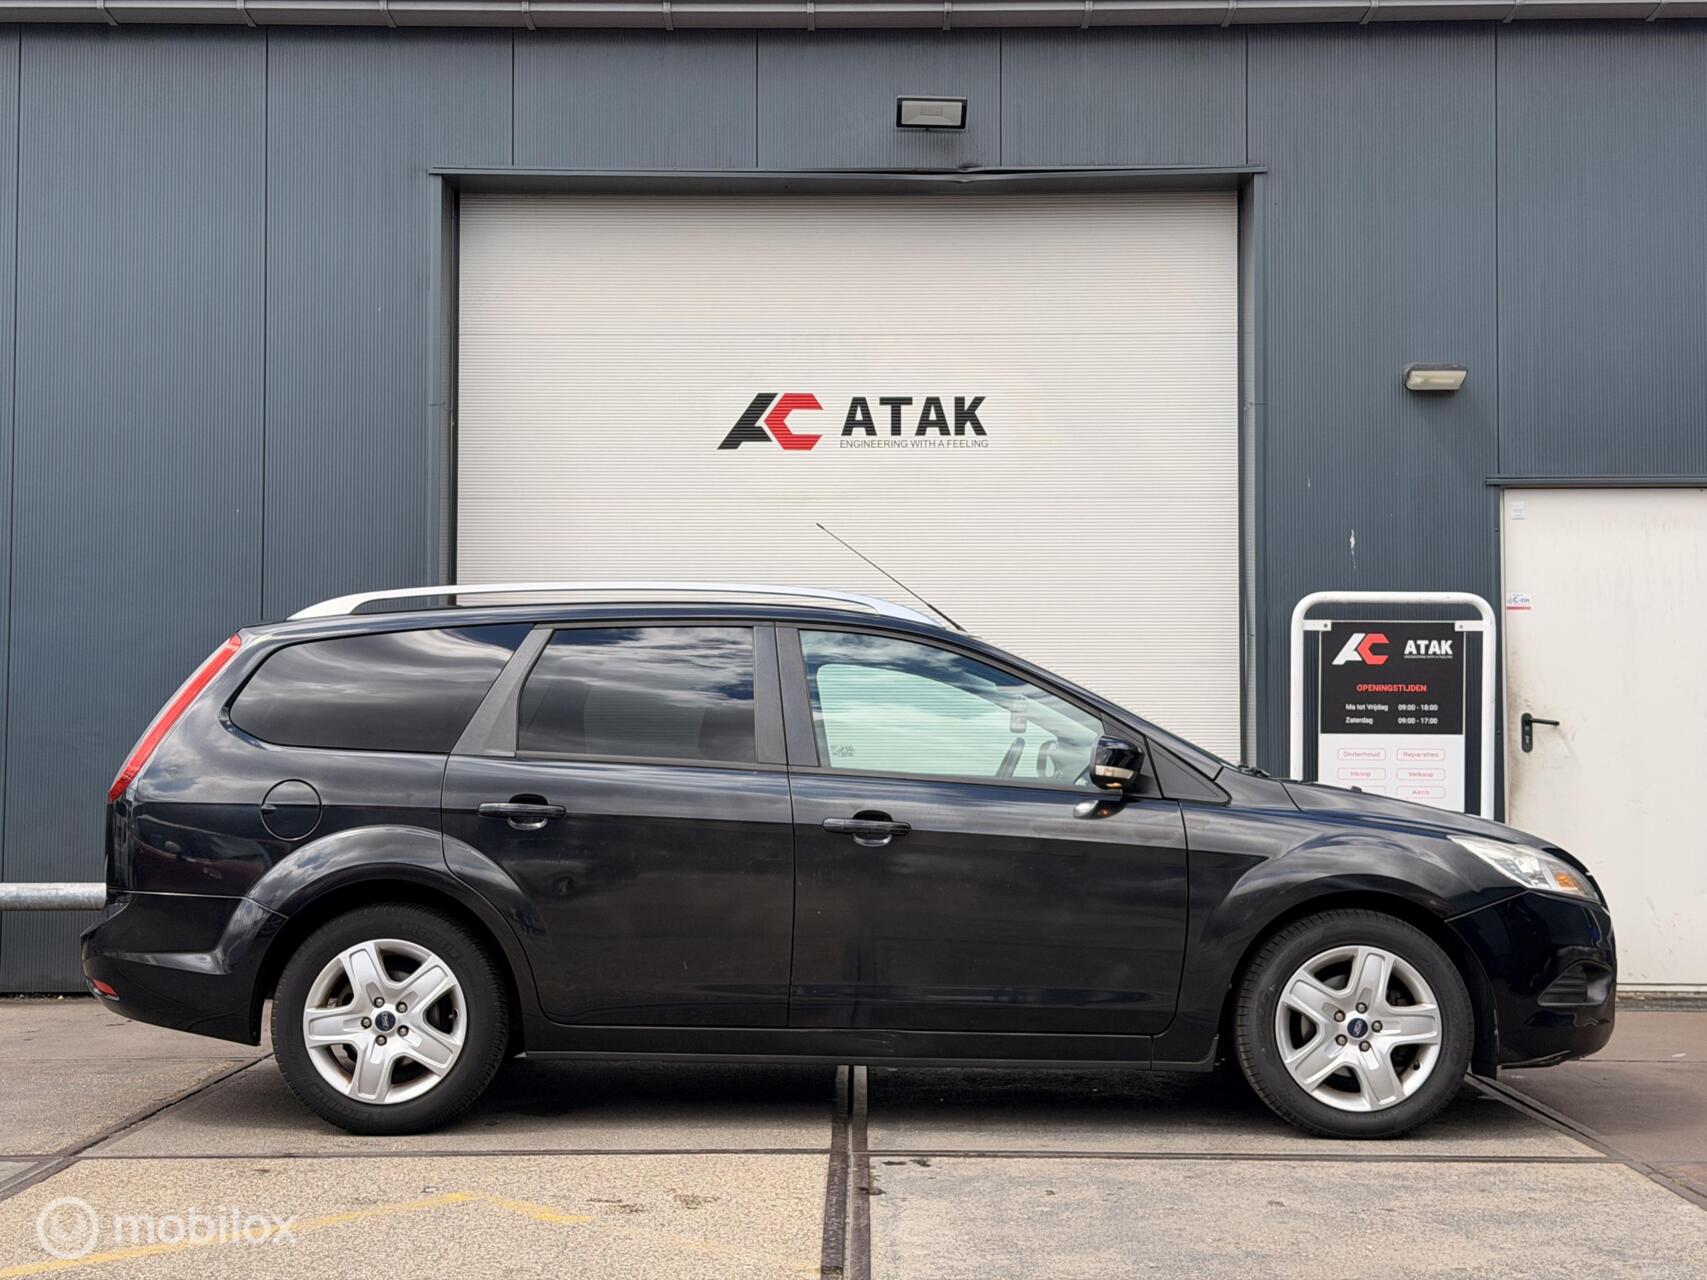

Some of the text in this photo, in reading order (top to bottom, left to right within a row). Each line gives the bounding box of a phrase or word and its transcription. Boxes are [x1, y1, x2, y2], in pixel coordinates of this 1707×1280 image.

[841, 396, 988, 436] ATAK
[840, 439, 989, 449] ENGINEERING WITH A FEELING
[1404, 639, 1453, 655] ATAK
[1356, 683, 1427, 693] OPENINGSTIJDEN
[1345, 703, 1356, 711] Ma
[1356, 703, 1366, 711] tot
[1366, 703, 1389, 712] Vrijdag
[1397, 703, 1416, 711] 09:00
[1421, 703, 1439, 711] 18:00
[1345, 716, 1374, 725] Zaterdag
[1397, 717, 1416, 725] 09:00
[1421, 717, 1439, 725] 17:00
